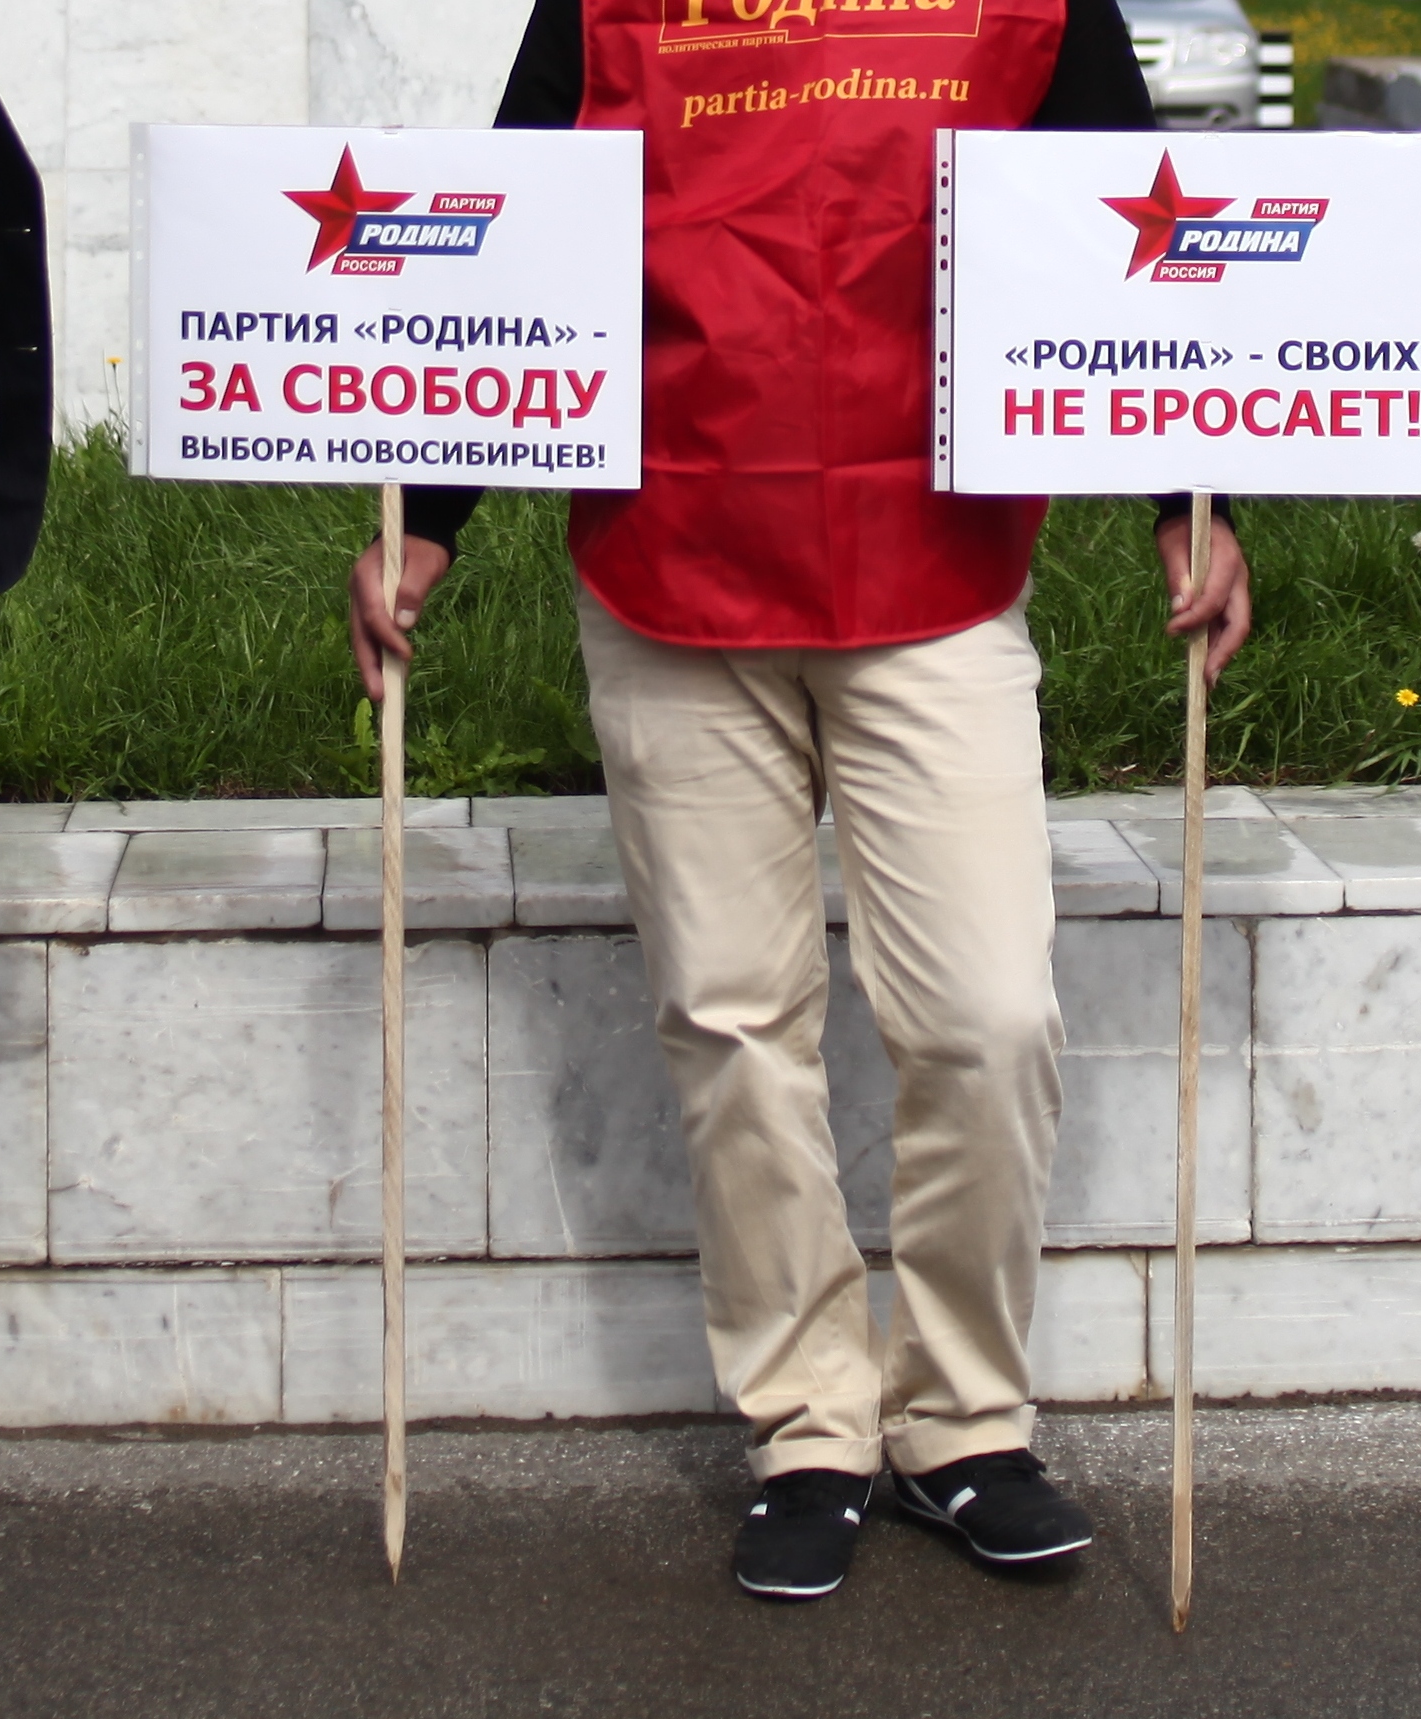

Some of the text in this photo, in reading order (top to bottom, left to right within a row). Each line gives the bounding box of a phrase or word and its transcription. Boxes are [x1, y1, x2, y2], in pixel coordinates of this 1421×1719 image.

[658, 33, 785, 55] политическая партия
[681, 67, 970, 128] partia-rodina.ru
[438, 197, 497, 211] ПАРТИЯ
[1260, 202, 1320, 216] ПАРТИЯ
[358, 223, 478, 248] РОДИНА
[1178, 229, 1300, 254] РОДИНА
[339, 259, 398, 273] РОССИЯ
[1158, 266, 1218, 280] РОССИЯ
[181, 310, 338, 344] ПАРТИЯ
[354, 314, 577, 352] «РОДИНА»
[1005, 339, 1234, 377] «РОДИНА»
[1277, 340, 1420, 372] СВОИХ
[180, 361, 607, 429] ЗА СВОБОДУ
[1004, 388, 1421, 437] НЕ БРОСАЕТ!
[181, 435, 606, 472] ВЫБОРА НОВОСИБИРЦЕВ!
